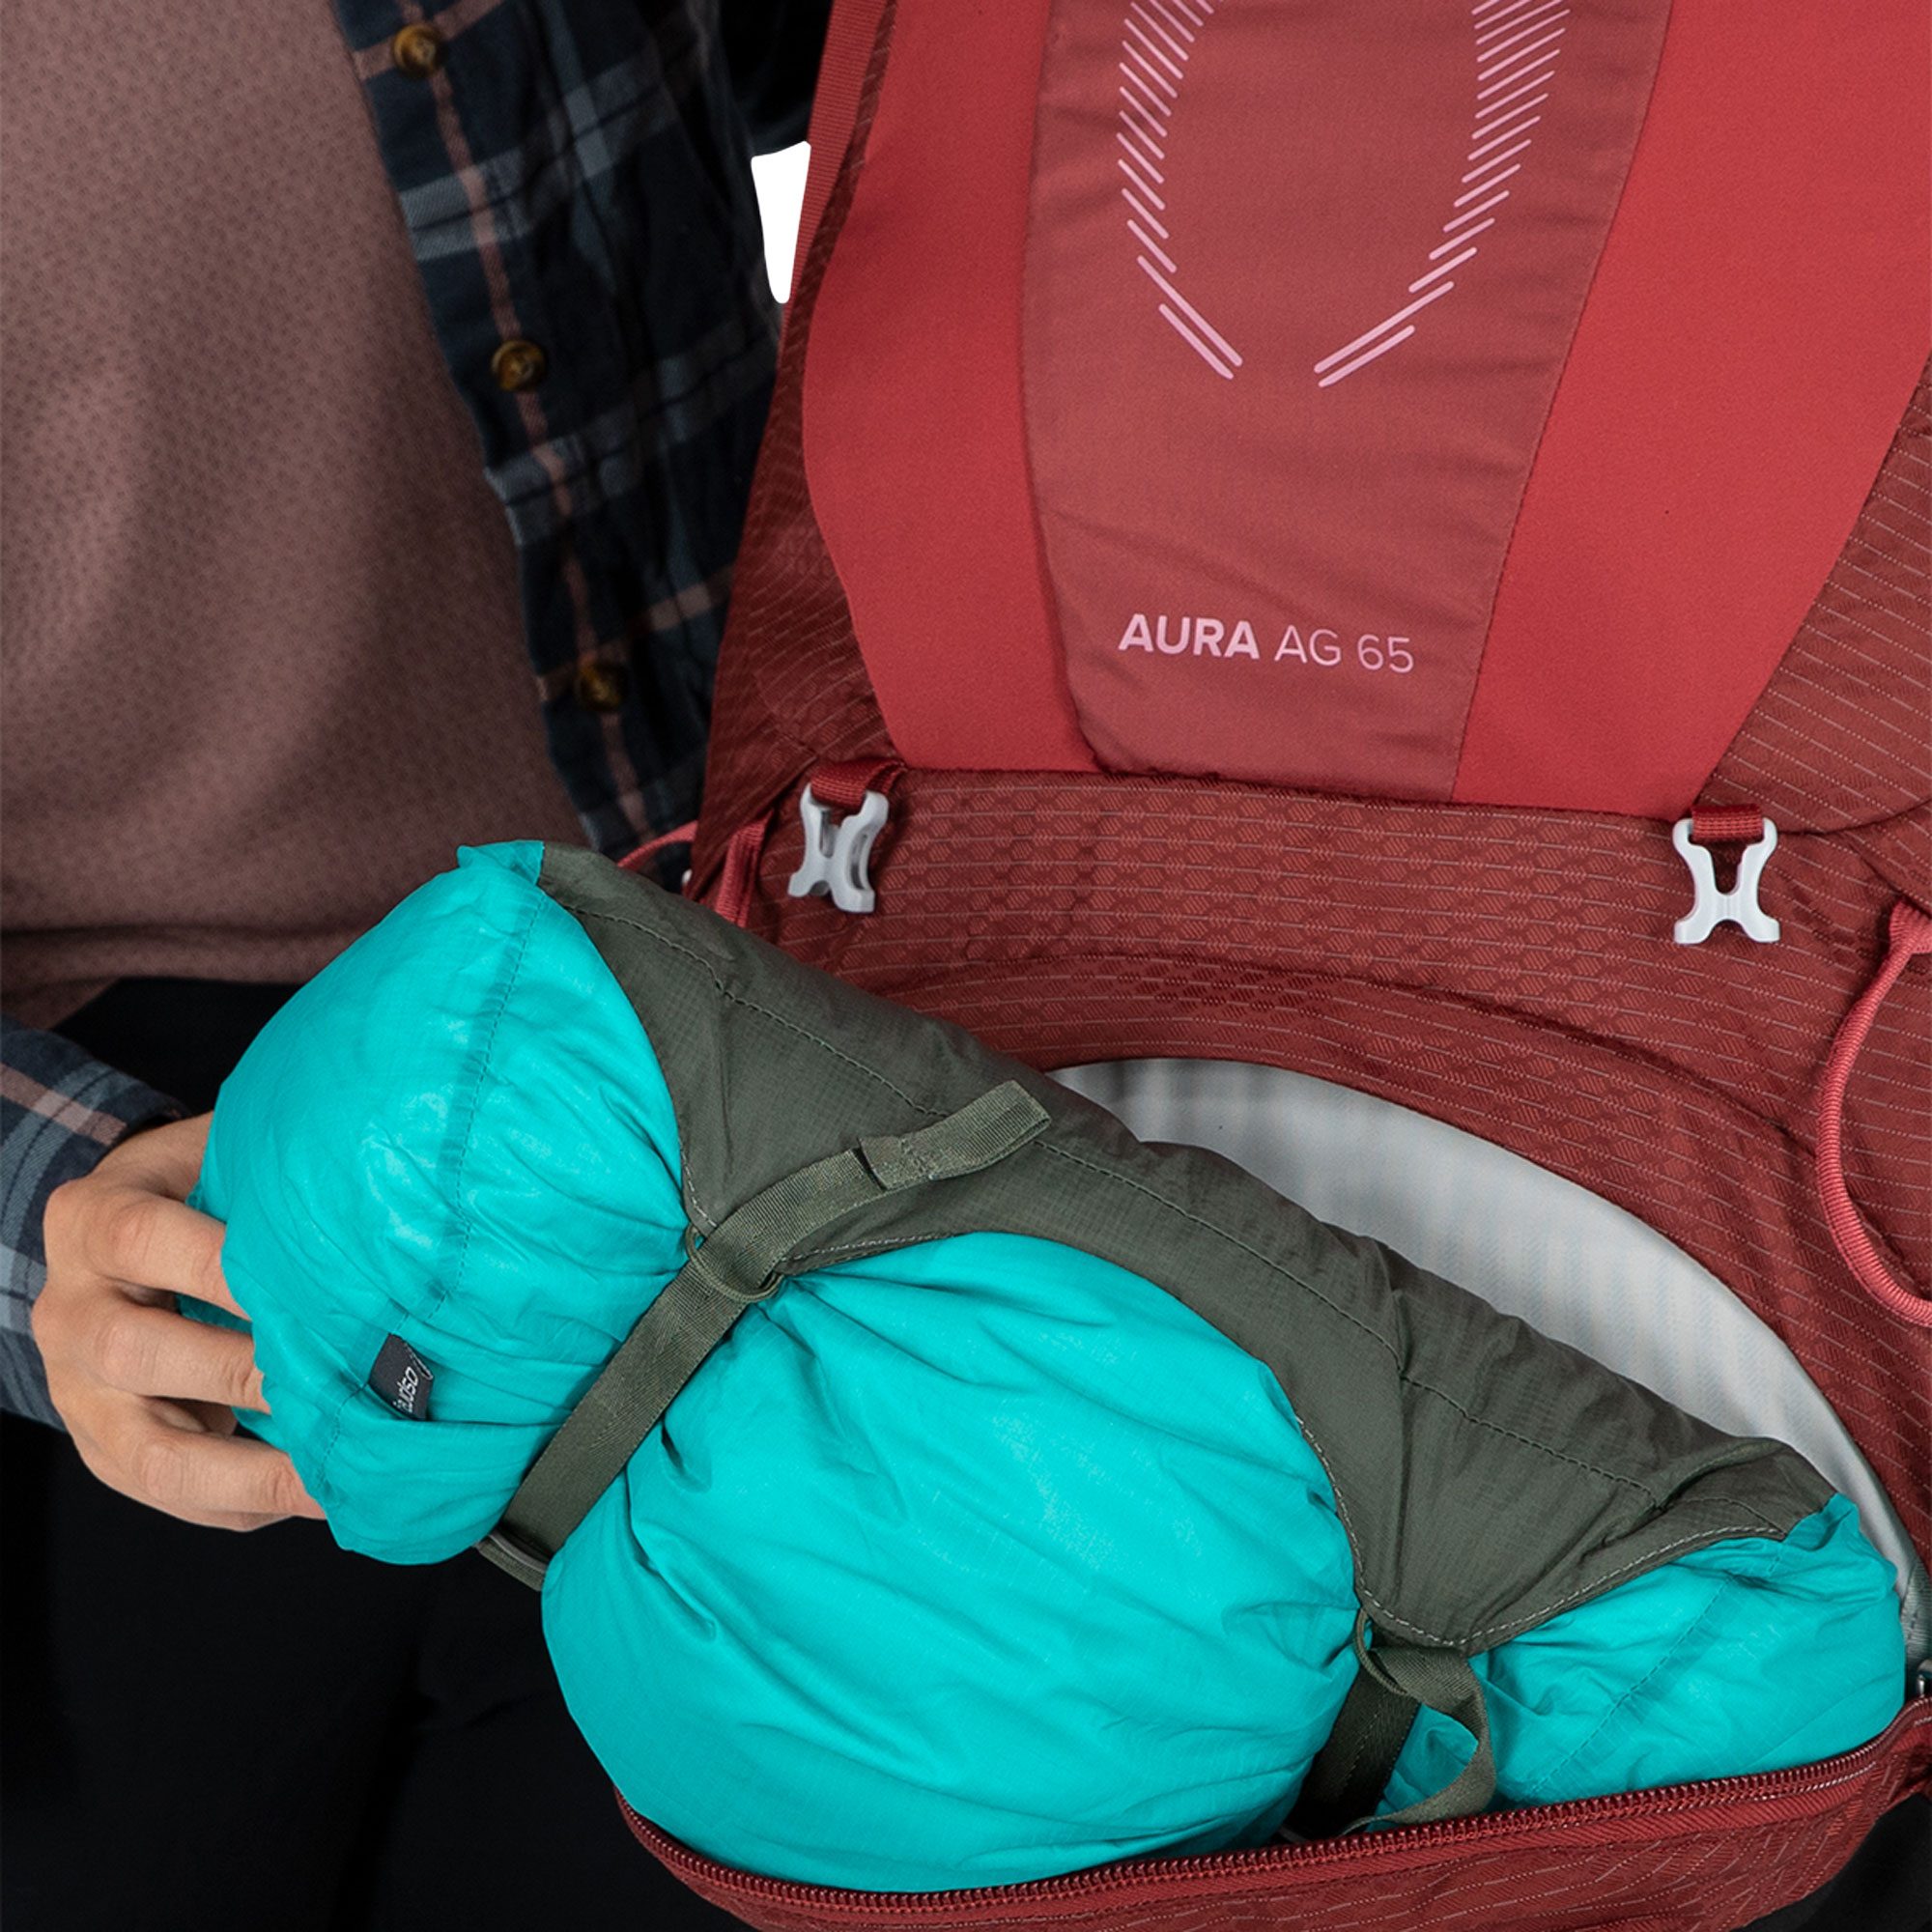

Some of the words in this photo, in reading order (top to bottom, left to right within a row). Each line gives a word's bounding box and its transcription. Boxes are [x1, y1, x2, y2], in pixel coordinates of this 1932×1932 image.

[1118, 613, 1260, 660] AURA
[1274, 625, 1342, 667] AG
[1357, 634, 1413, 673] 65
